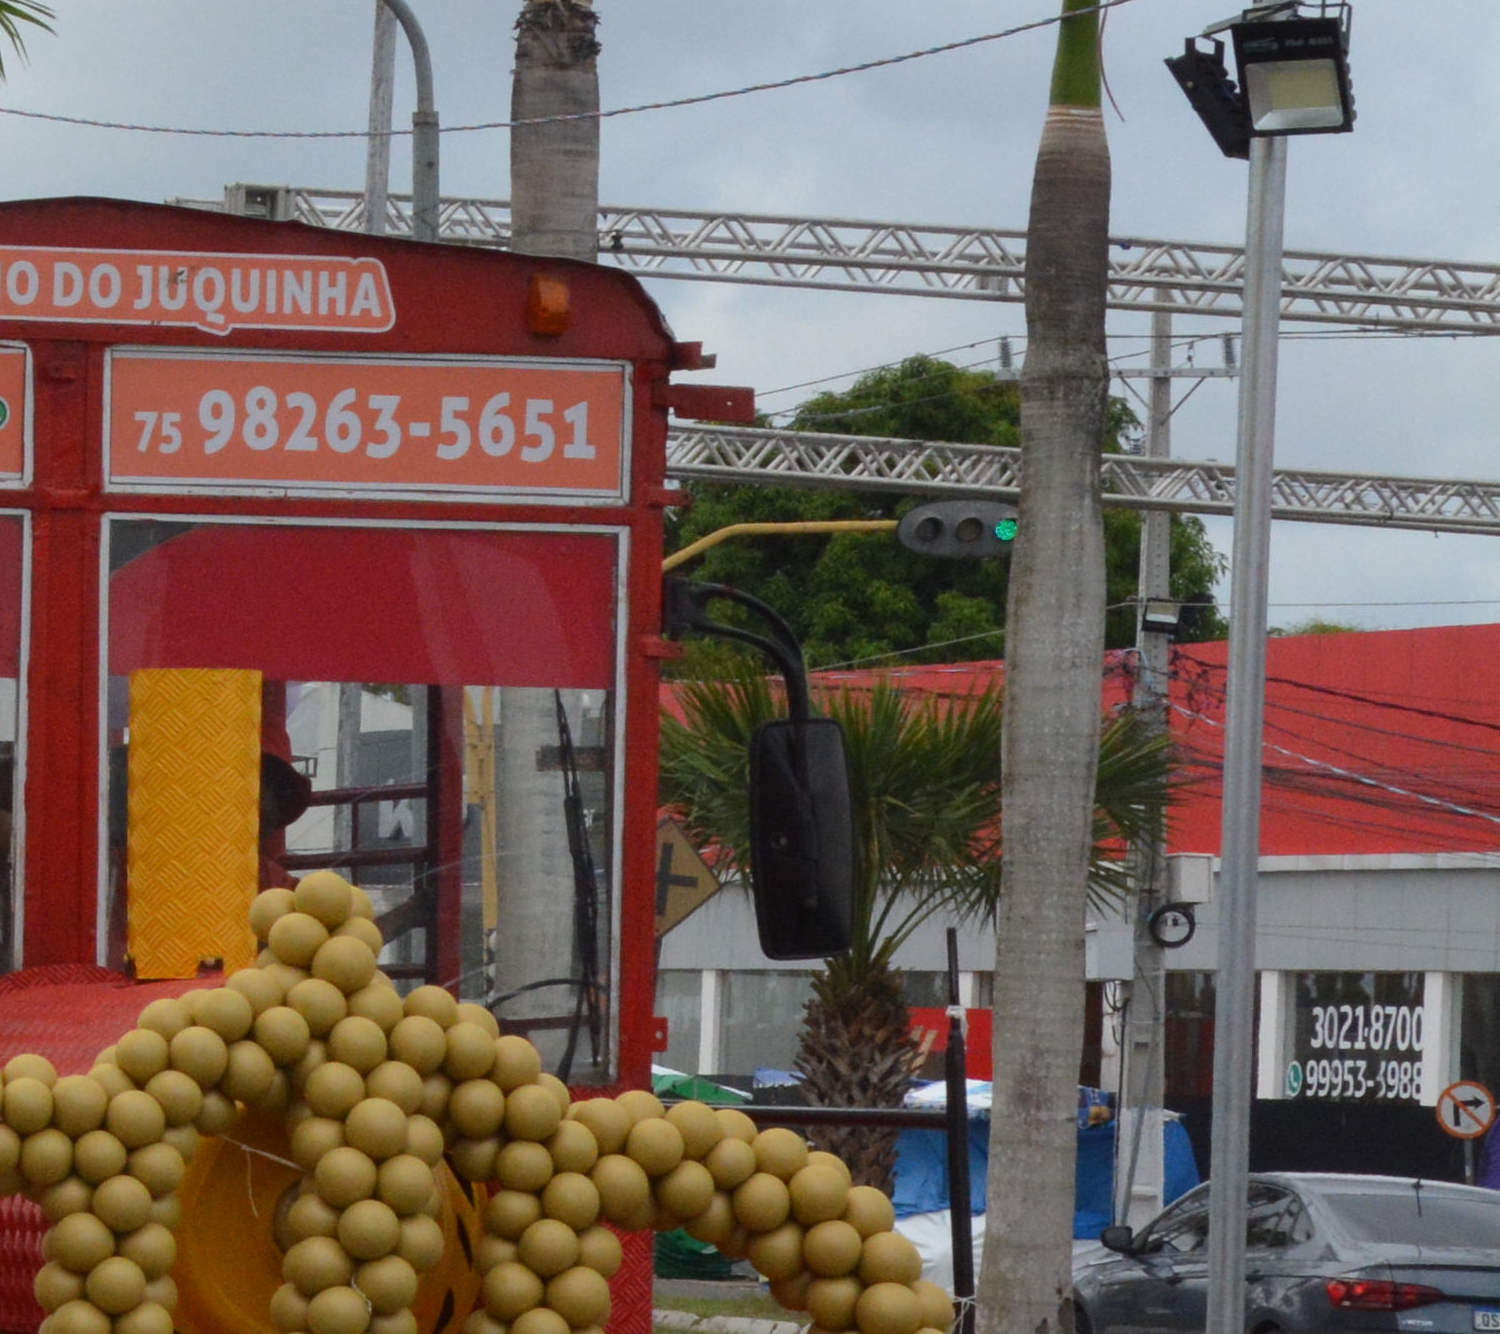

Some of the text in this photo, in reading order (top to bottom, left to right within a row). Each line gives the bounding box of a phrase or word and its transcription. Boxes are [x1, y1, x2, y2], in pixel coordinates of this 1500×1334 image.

[52, 261, 123, 309] DO
[132, 264, 383, 326] JUQUINHA
[134, 385, 596, 463] 75 98263-5651
